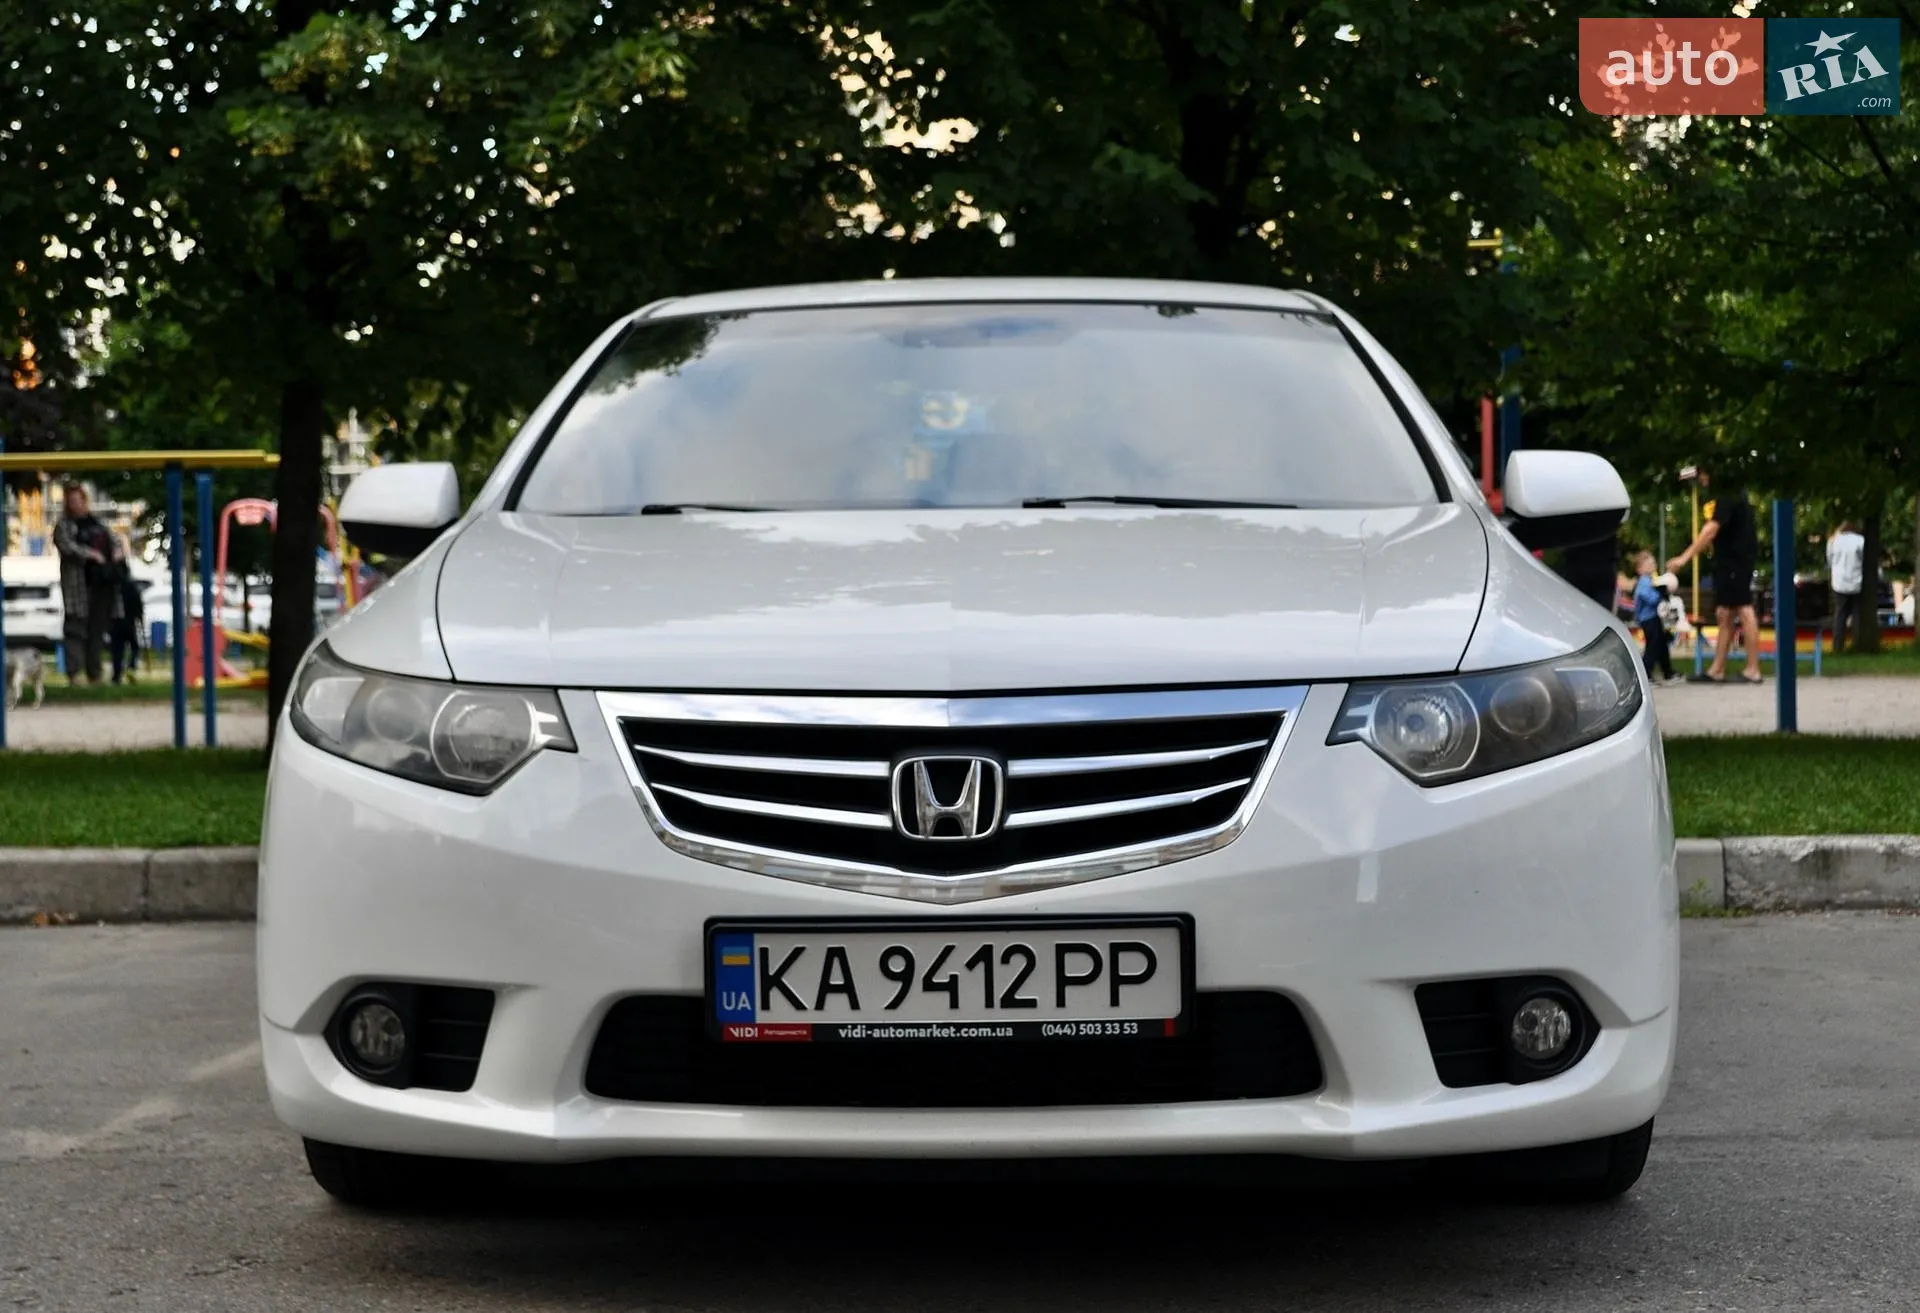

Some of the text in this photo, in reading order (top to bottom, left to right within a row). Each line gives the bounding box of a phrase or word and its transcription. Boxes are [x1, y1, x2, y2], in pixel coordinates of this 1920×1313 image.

[759, 941, 1158, 1011] KA 9412 PP
[722, 991, 752, 1011] UA
[728, 1027, 759, 1038] VIDI
[838, 1024, 1014, 1038] vidi-automarket.com.ua
[1041, 1022, 1139, 1037] (044) 503 33 53
